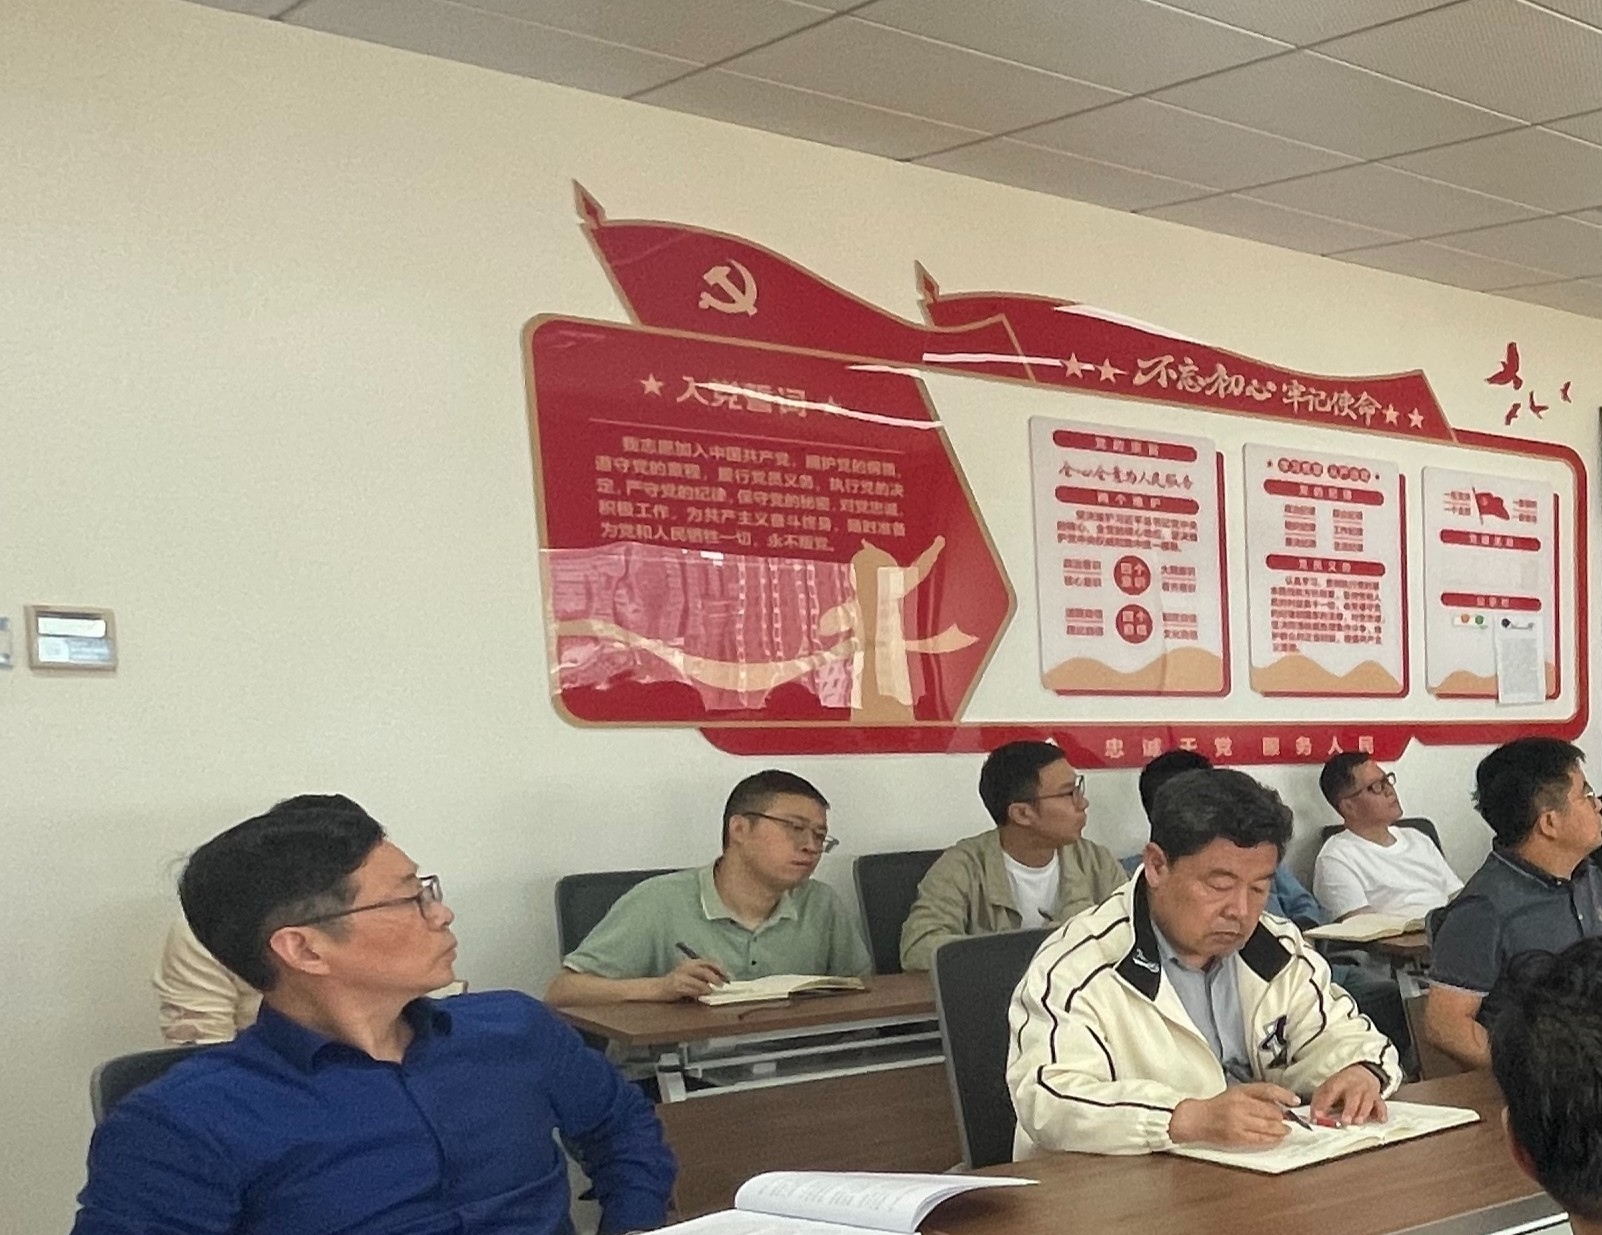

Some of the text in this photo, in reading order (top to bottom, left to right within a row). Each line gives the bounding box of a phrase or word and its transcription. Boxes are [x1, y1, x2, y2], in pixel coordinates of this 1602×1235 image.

[677, 376, 807, 417] 入党誓词
[1133, 355, 1382, 426] 不忘初心 牢记使命
